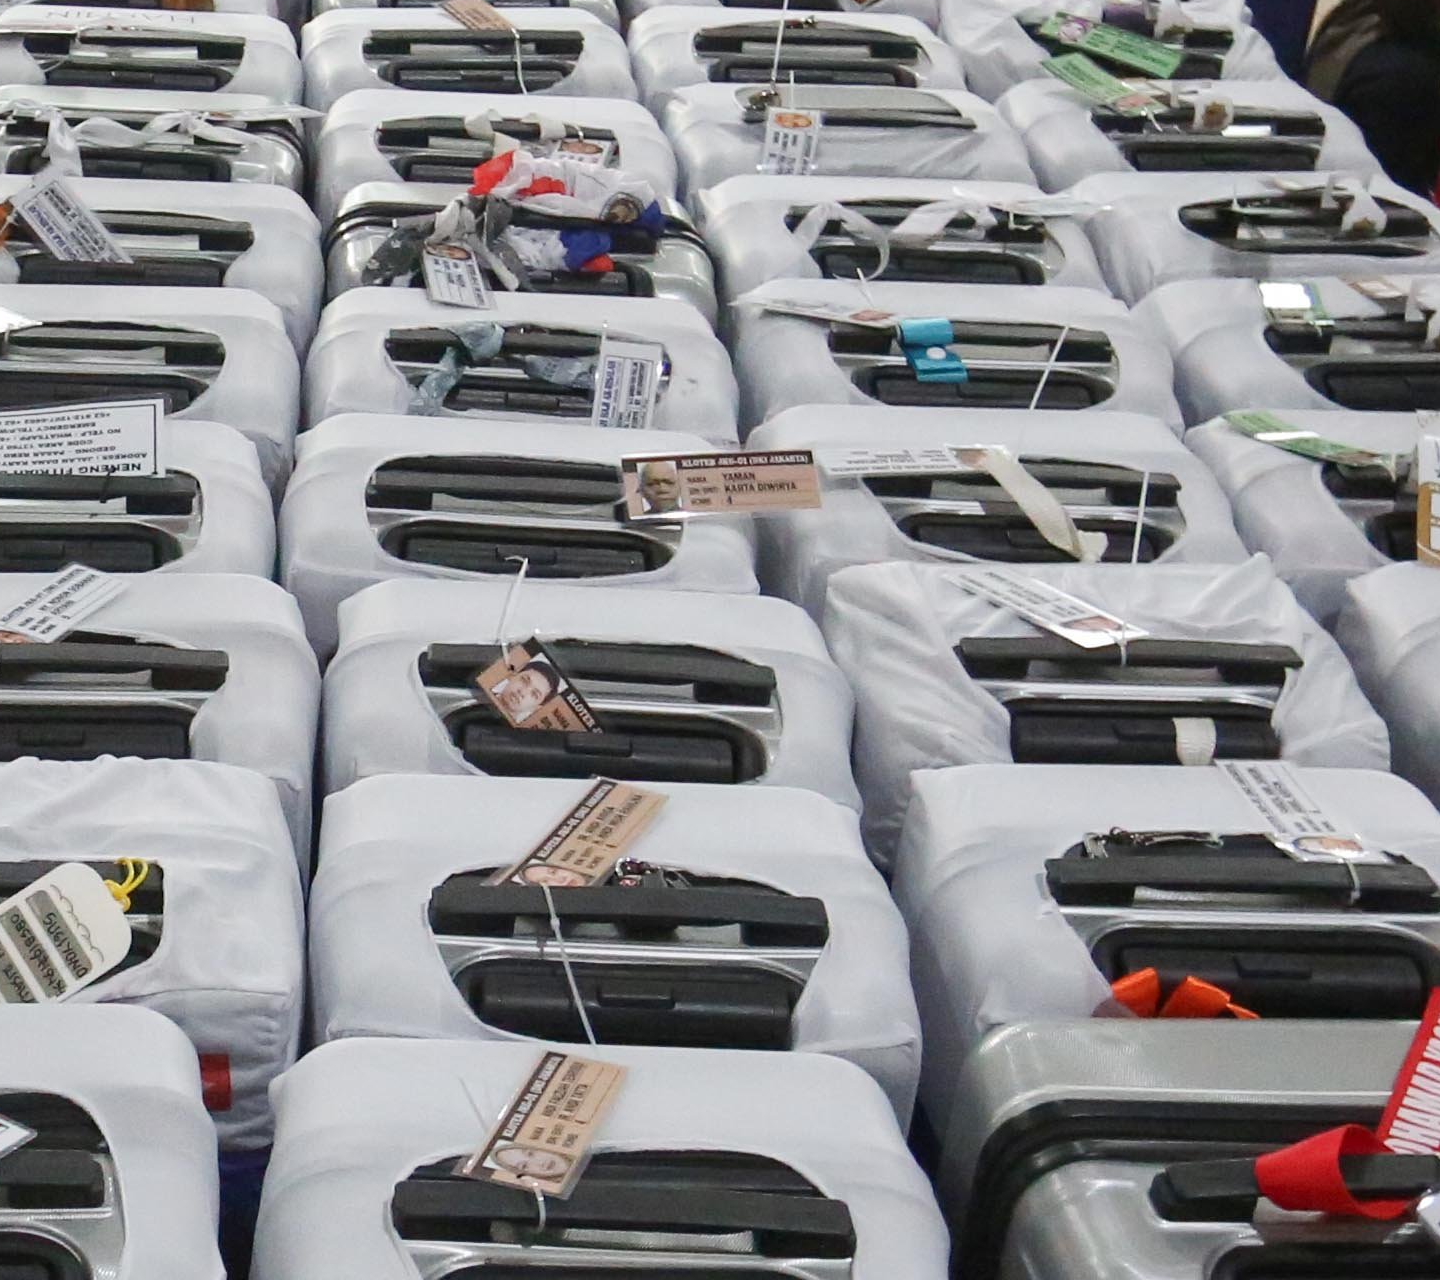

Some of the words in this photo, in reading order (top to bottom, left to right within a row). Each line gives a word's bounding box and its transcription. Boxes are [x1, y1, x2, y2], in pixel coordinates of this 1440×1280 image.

[35, 421, 96, 432] EMERGENCY
[18, 432, 71, 440] WHATSAPP
[74, 445, 116, 454] GEDONG
[61, 455, 93, 463] JALAN
[101, 452, 147, 460] ADDRESS
[682, 458, 715, 467] KLOTER
[77, 462, 141, 473] NENENG
[722, 472, 755, 481] YAMAN
[724, 483, 754, 492] KARTA
[757, 481, 797, 491] DIWIRYA
